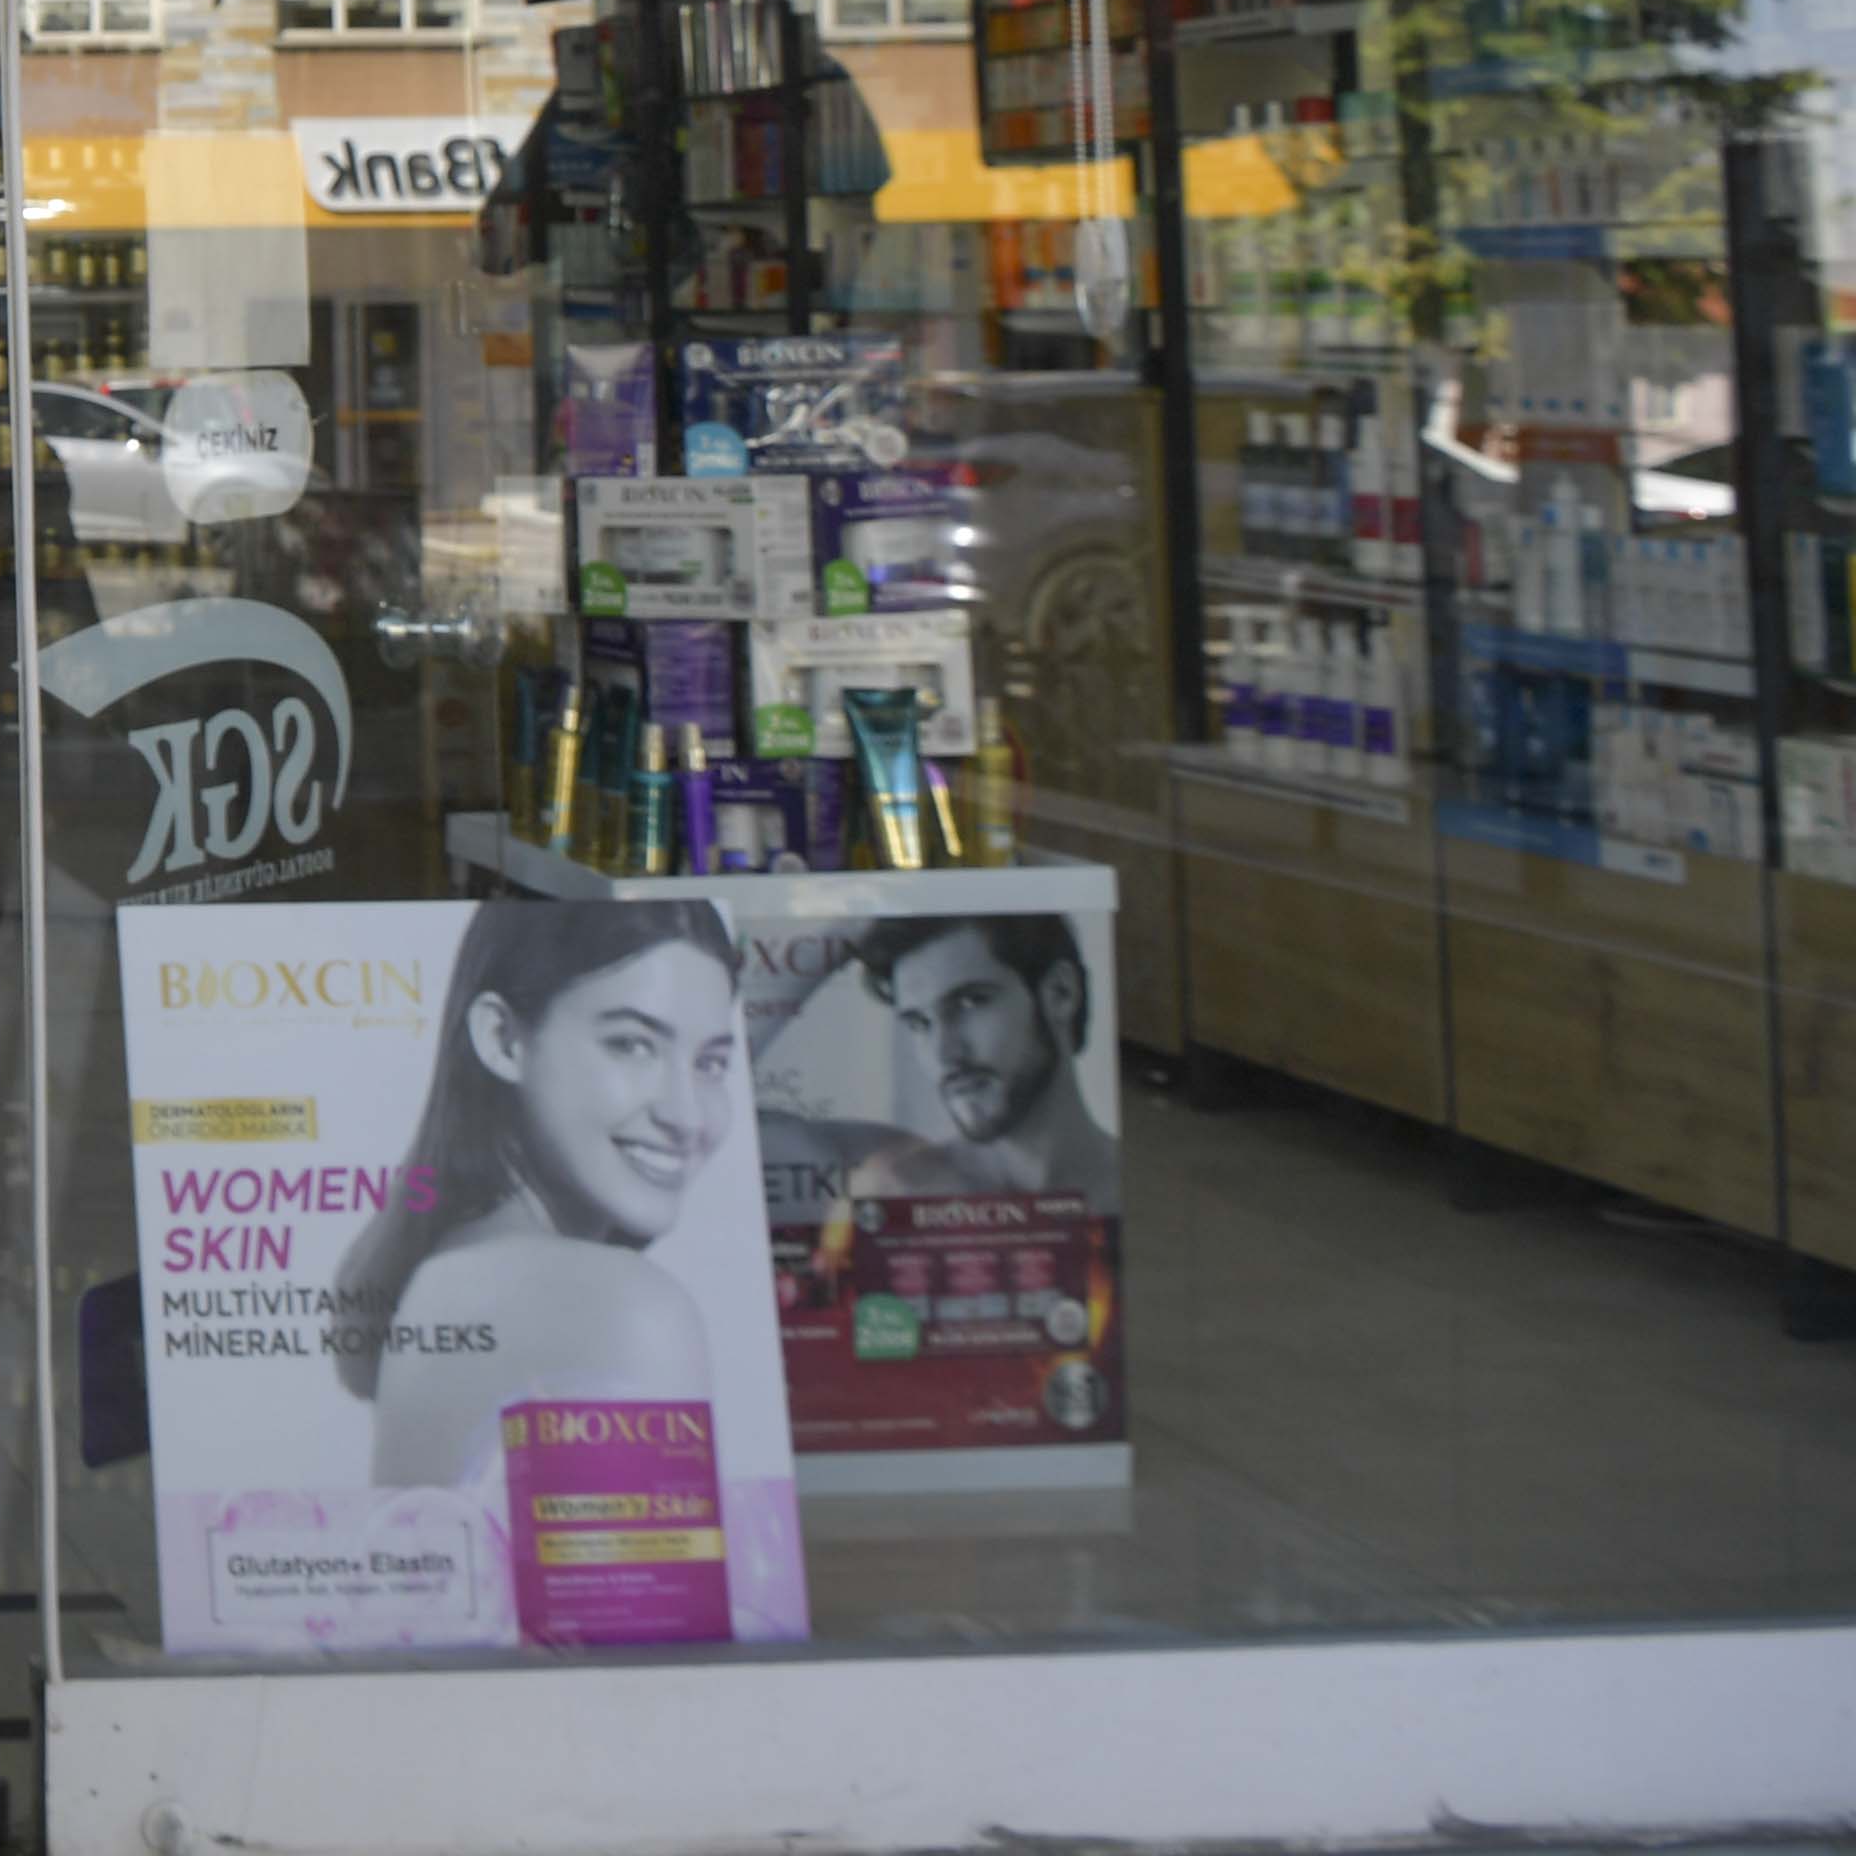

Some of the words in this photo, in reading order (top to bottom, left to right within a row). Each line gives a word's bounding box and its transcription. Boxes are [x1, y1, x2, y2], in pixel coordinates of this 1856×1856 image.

[161, 1165, 440, 1214] WOMEN'S
[163, 1225, 292, 1273] SKIN
[164, 1322, 310, 1358] MİNERAL
[320, 1323, 498, 1356] KOMPLEKS
